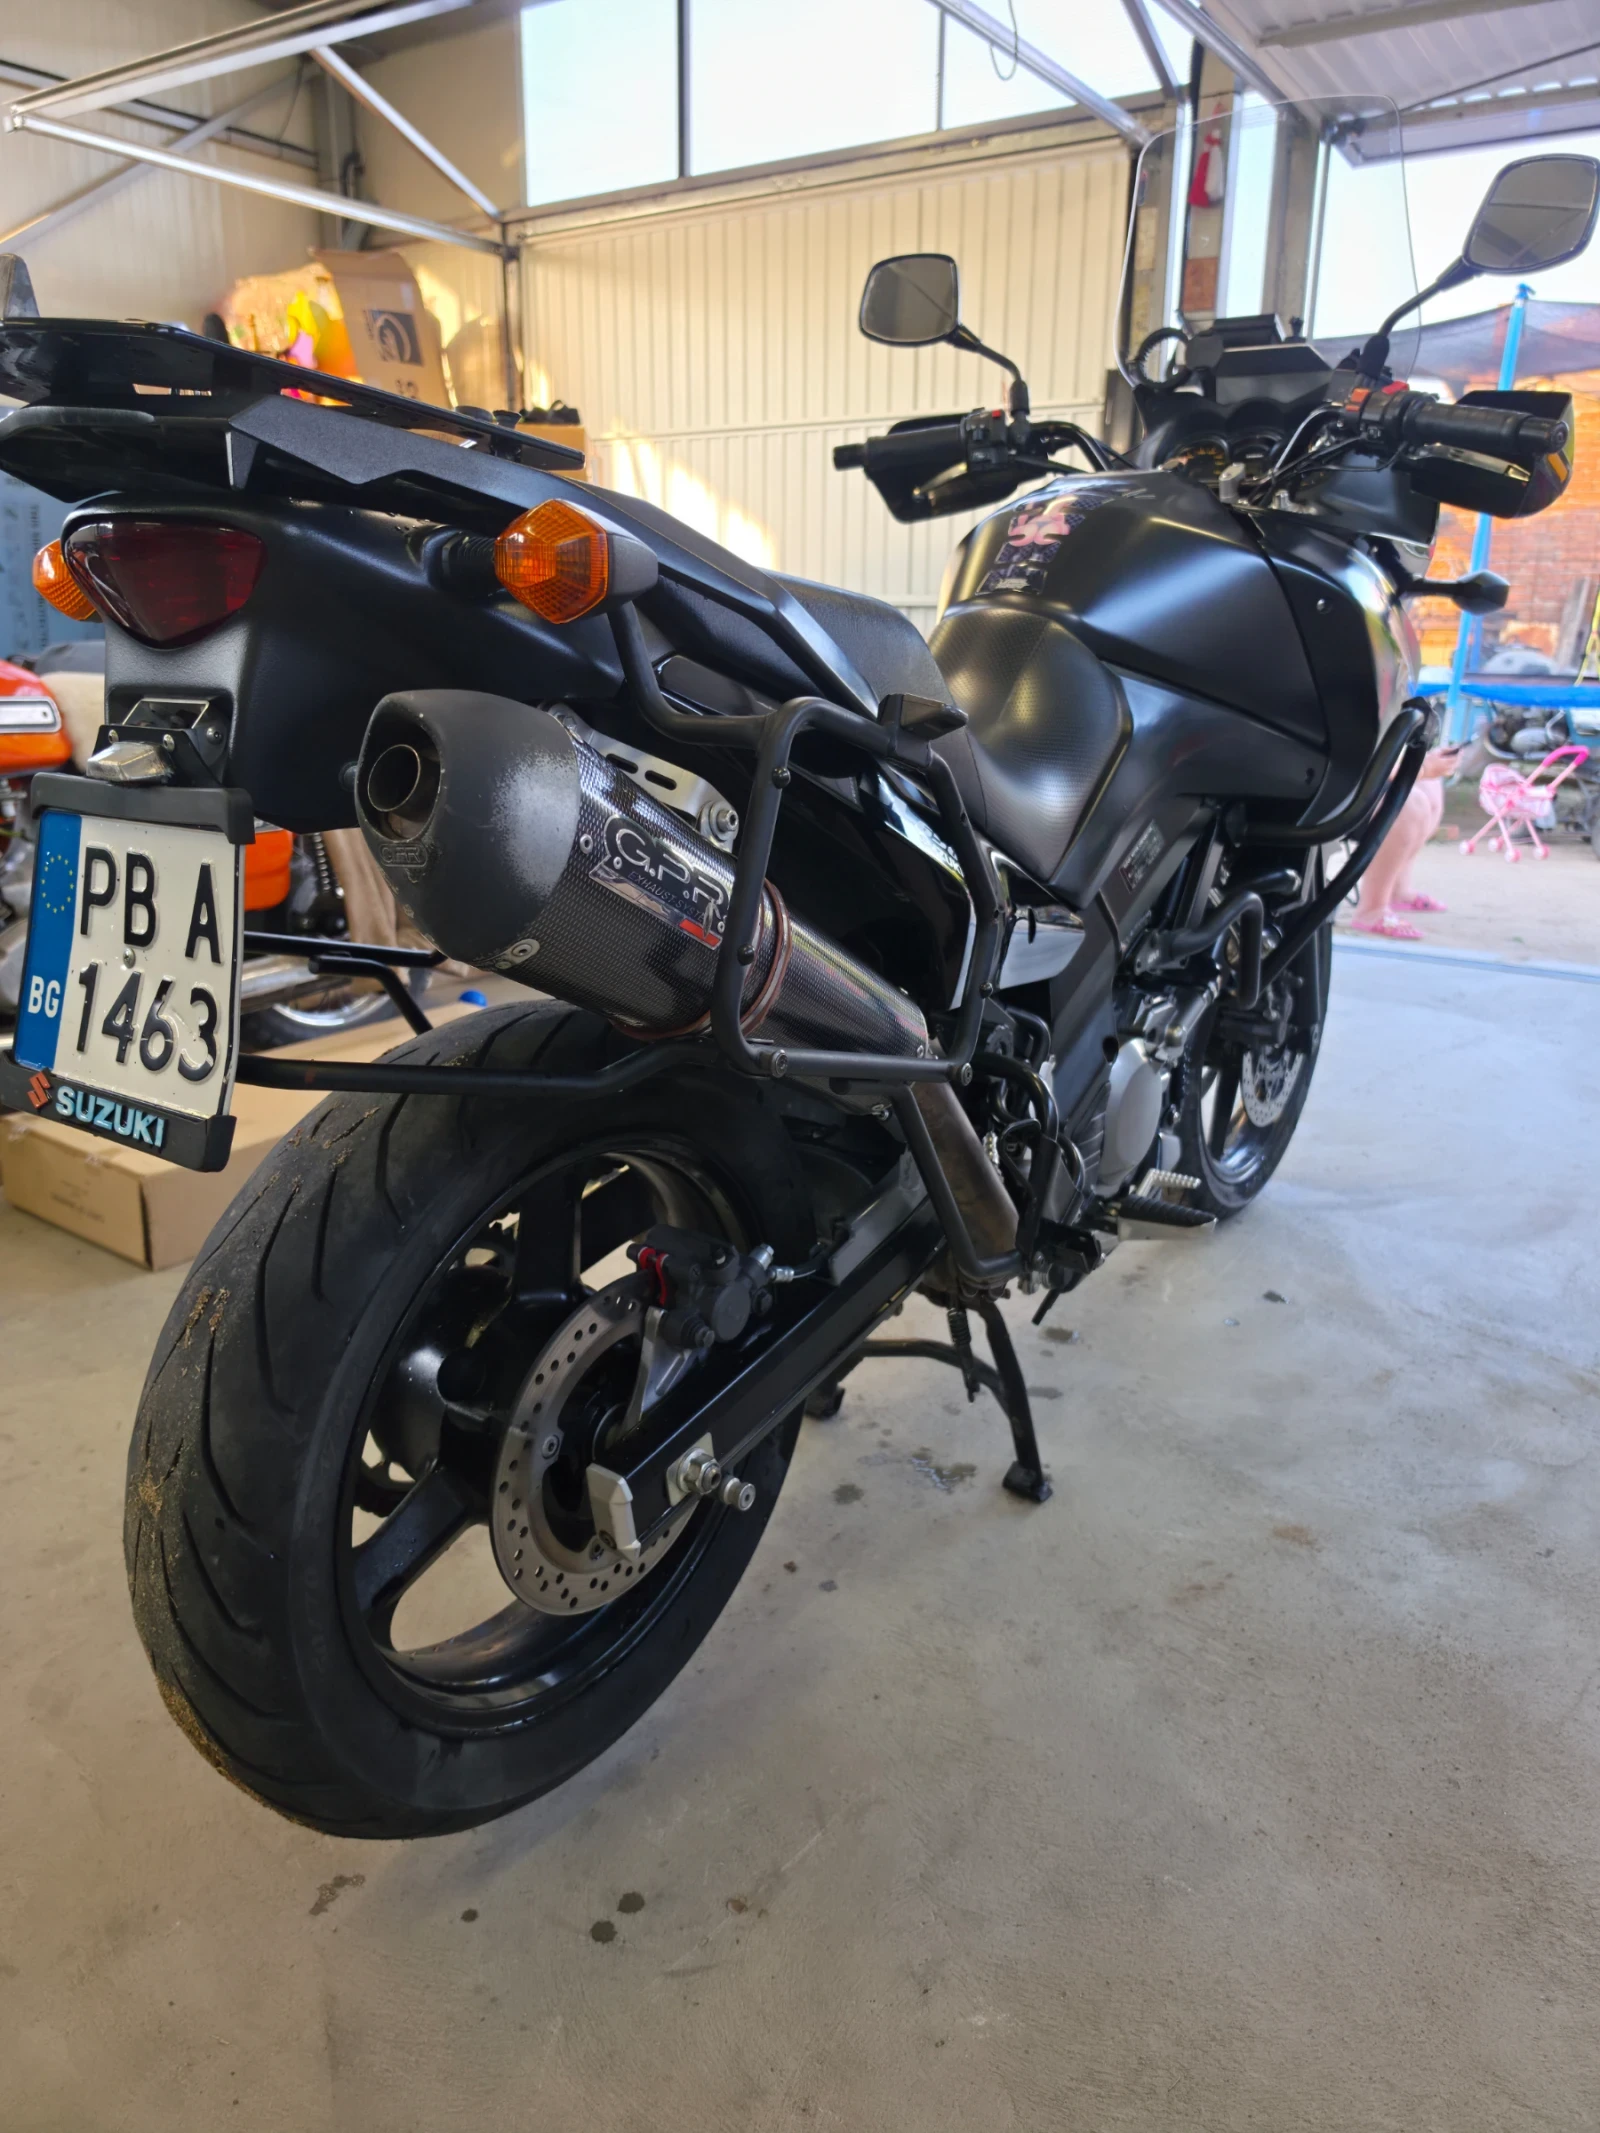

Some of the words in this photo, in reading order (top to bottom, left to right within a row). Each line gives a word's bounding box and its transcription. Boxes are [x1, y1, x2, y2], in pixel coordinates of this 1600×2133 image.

[80, 845, 156, 948] PB
[185, 862, 222, 964] A
[27, 976, 61, 1019] BG
[76, 961, 219, 1083] 1463
[55, 1085, 166, 1148] SUZUKI
